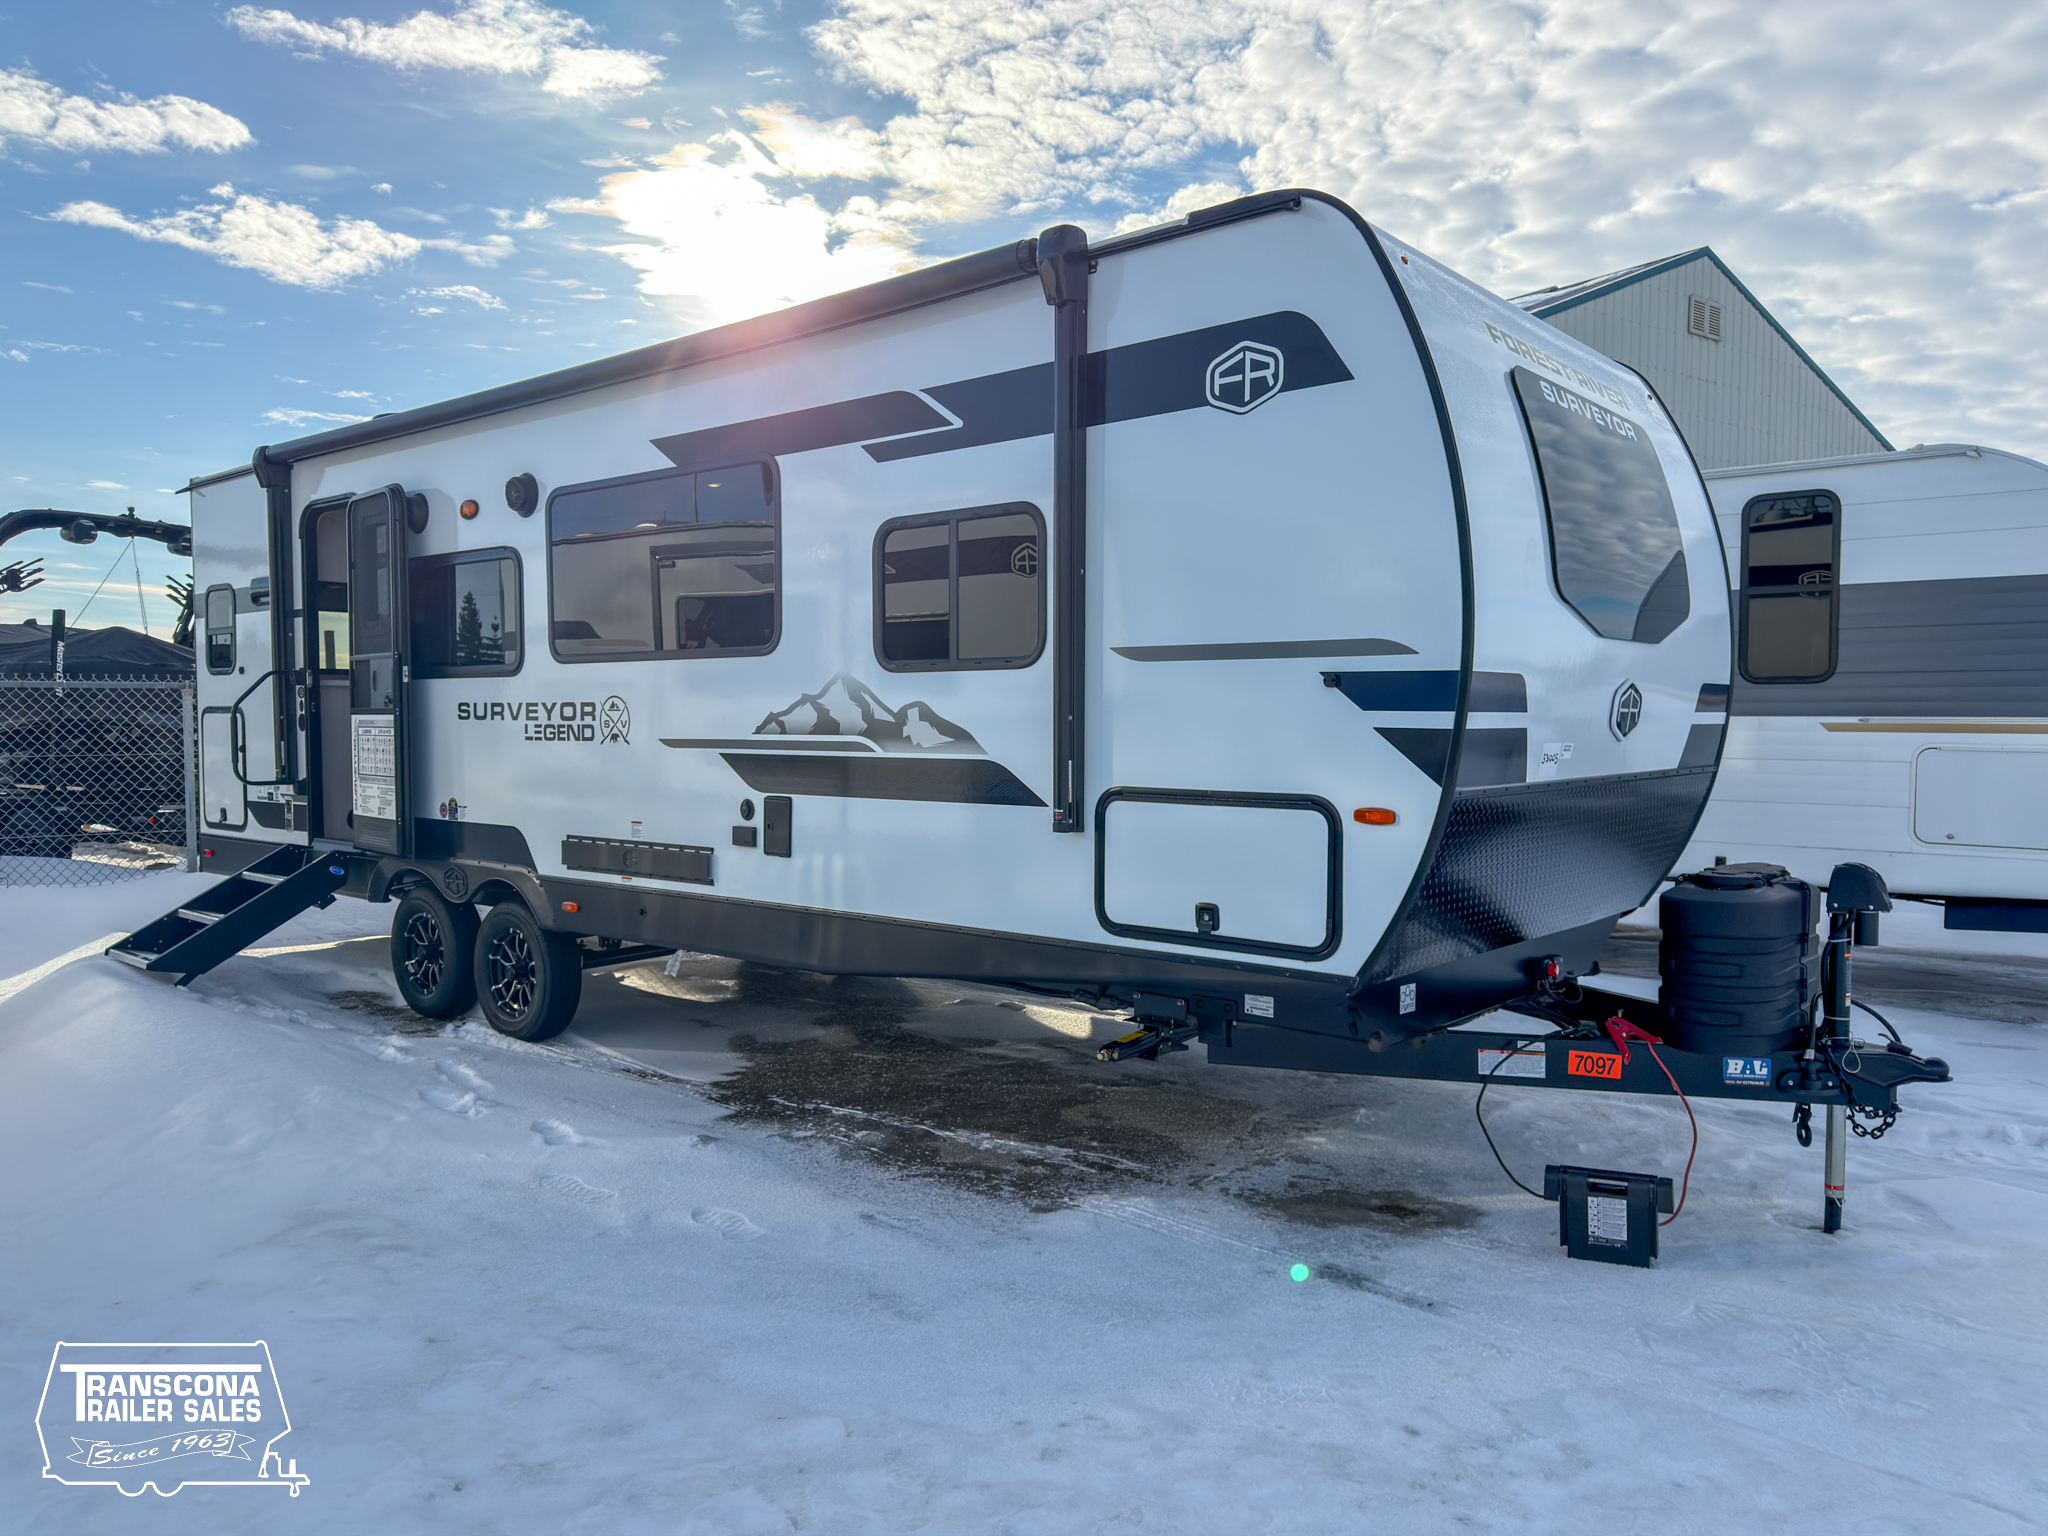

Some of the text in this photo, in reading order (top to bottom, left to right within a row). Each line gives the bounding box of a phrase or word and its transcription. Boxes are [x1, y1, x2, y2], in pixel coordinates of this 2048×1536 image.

[1482, 320, 1632, 411] FOREST RIVER
[1540, 380, 1638, 441] SURVEYOR
[55, 640, 66, 697] MasterCft
[457, 702, 597, 721] SURVEYOR
[524, 723, 595, 742] LEGEND
[1574, 1054, 1616, 1075] 7097
[1727, 1059, 1768, 1075] BAL
